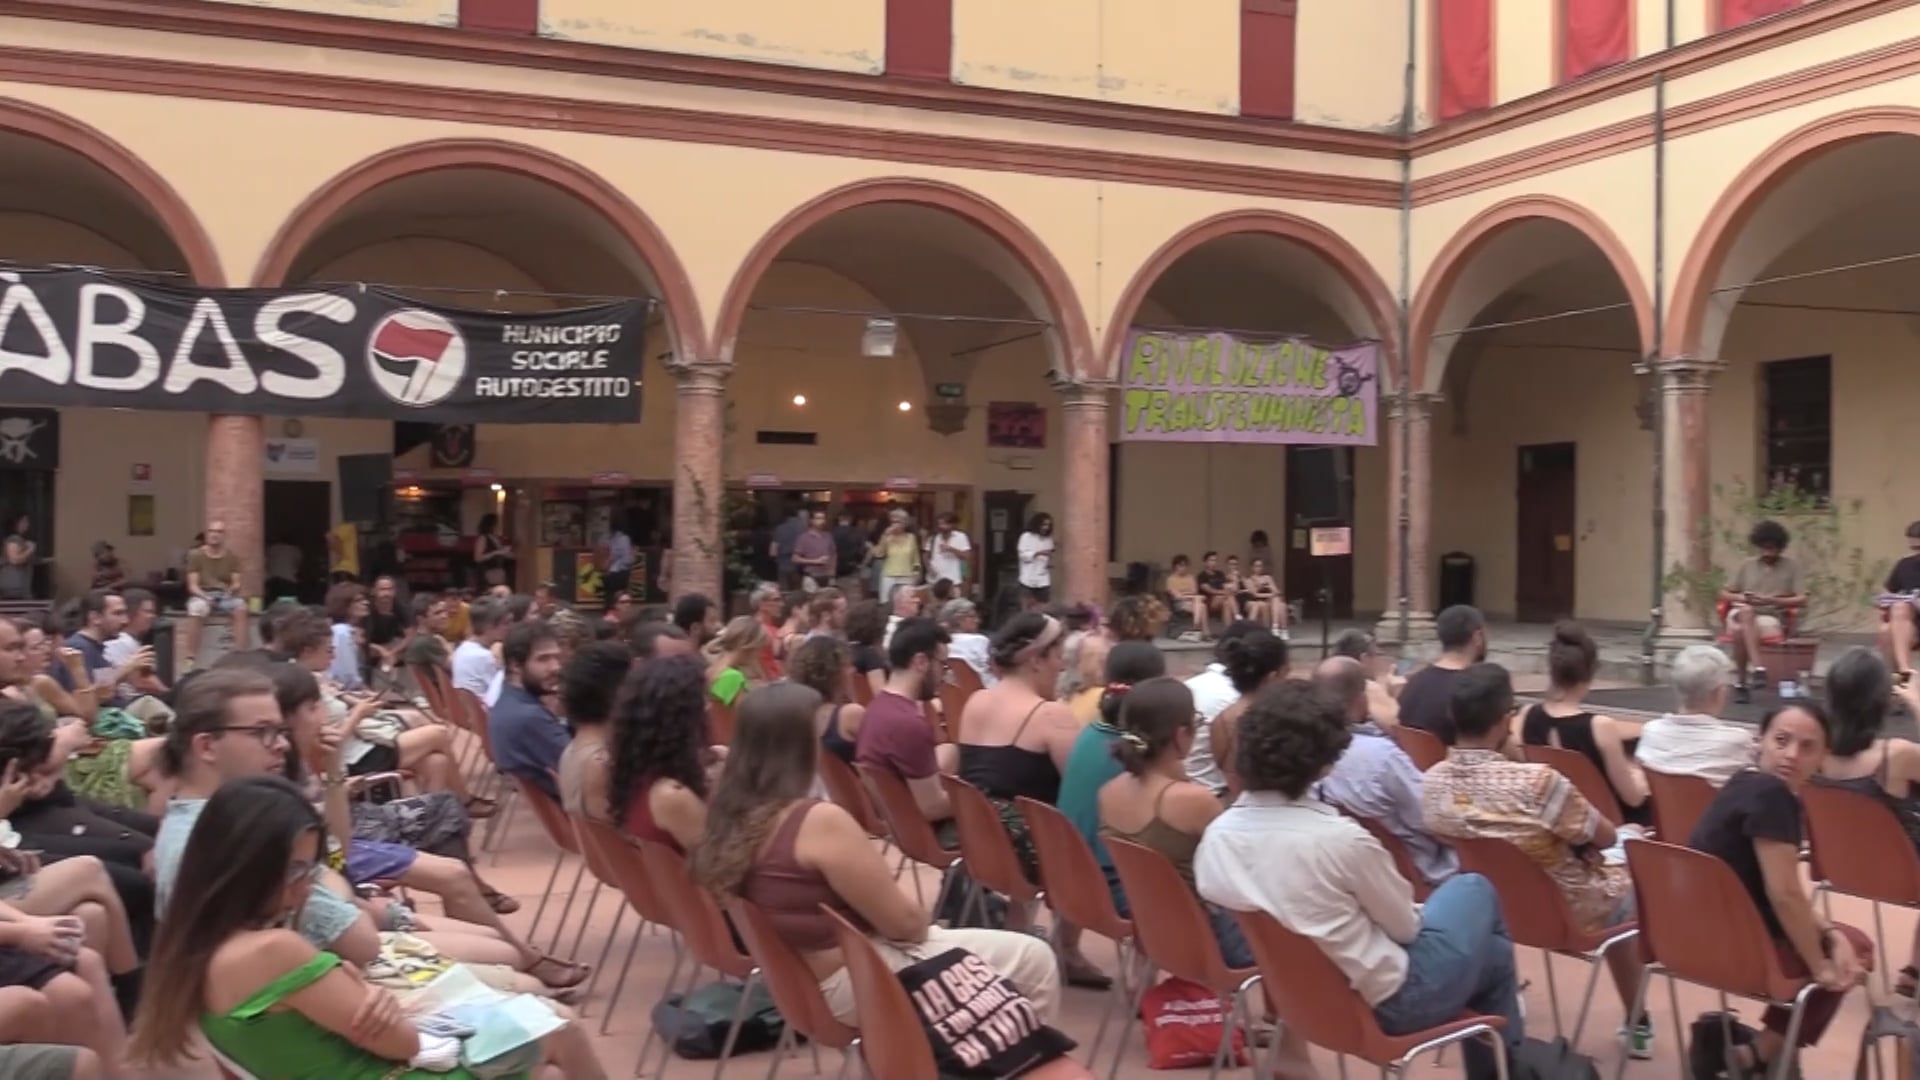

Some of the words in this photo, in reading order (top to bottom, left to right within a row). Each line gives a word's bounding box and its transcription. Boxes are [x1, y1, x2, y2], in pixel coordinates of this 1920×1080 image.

[511, 350, 609, 370] SOCIALE
[1128, 334, 1330, 389] RIVOLUZIONE
[475, 377, 630, 397] AUTOGESTITO
[911, 979, 956, 1024] LA
[940, 954, 996, 1003] CAS
[952, 1033, 991, 1068] DI
